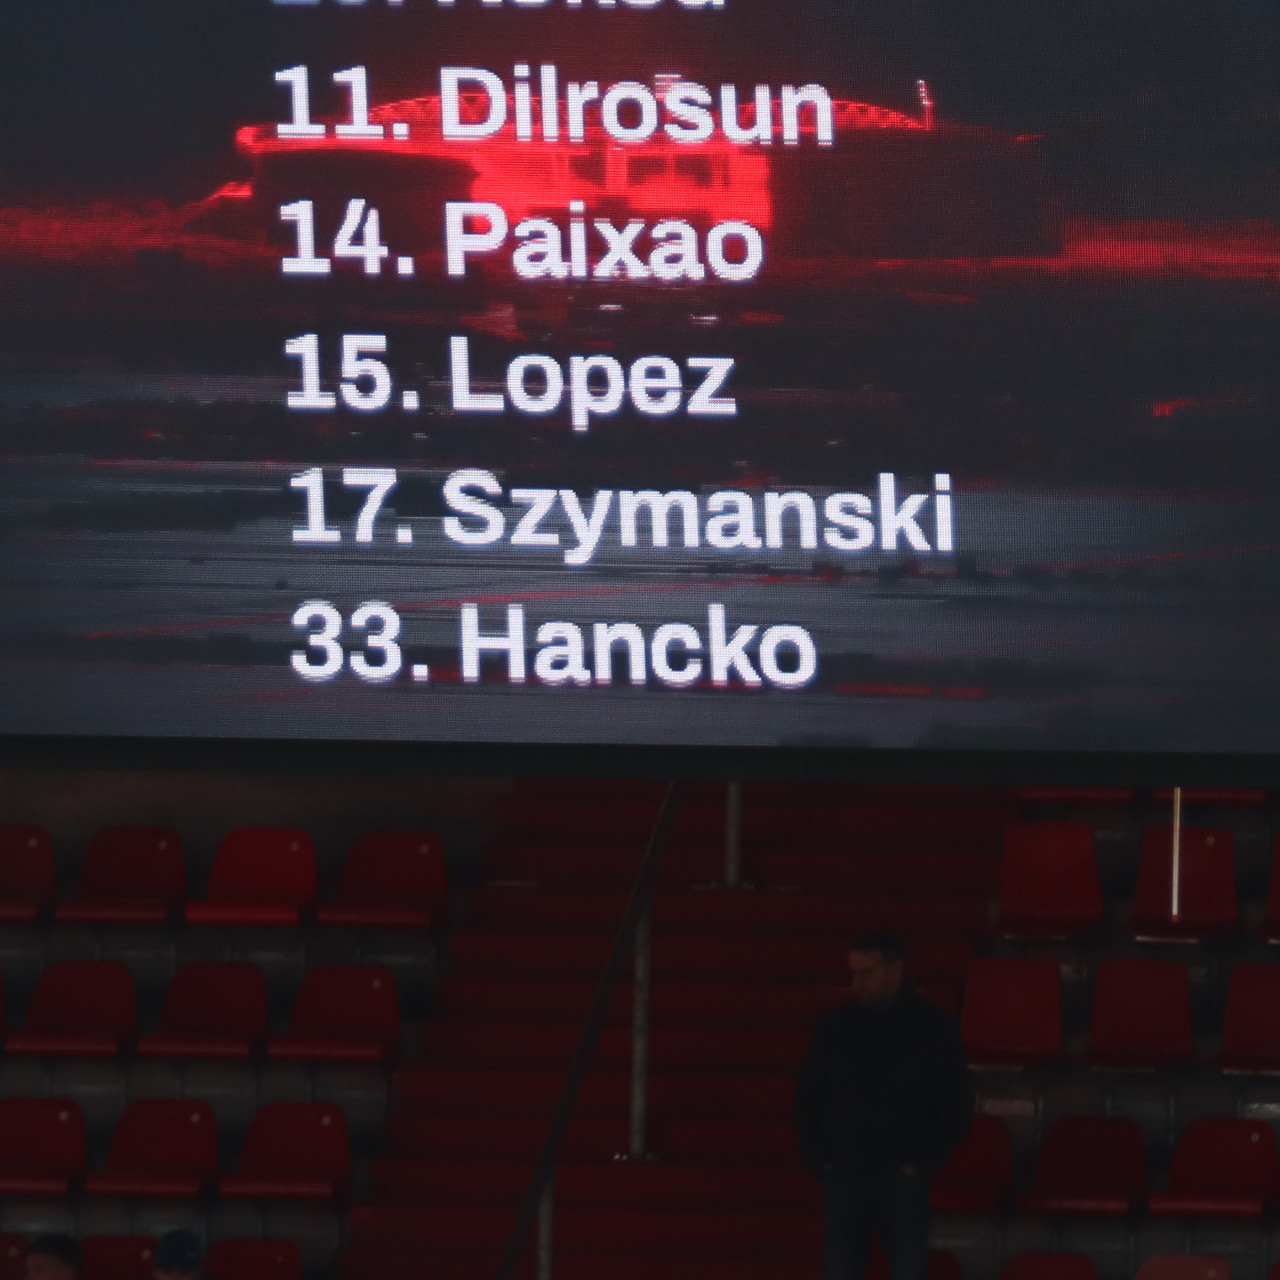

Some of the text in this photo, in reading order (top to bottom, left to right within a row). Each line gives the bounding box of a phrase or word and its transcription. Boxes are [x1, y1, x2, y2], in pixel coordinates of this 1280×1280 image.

[274, 63, 834, 146] 11. Dilrosun
[280, 198, 764, 280] 14. Paixao
[285, 333, 738, 432] 15. Lopez
[289, 467, 954, 566] 17. Szymanski
[290, 600, 817, 689] 33. Hancko
